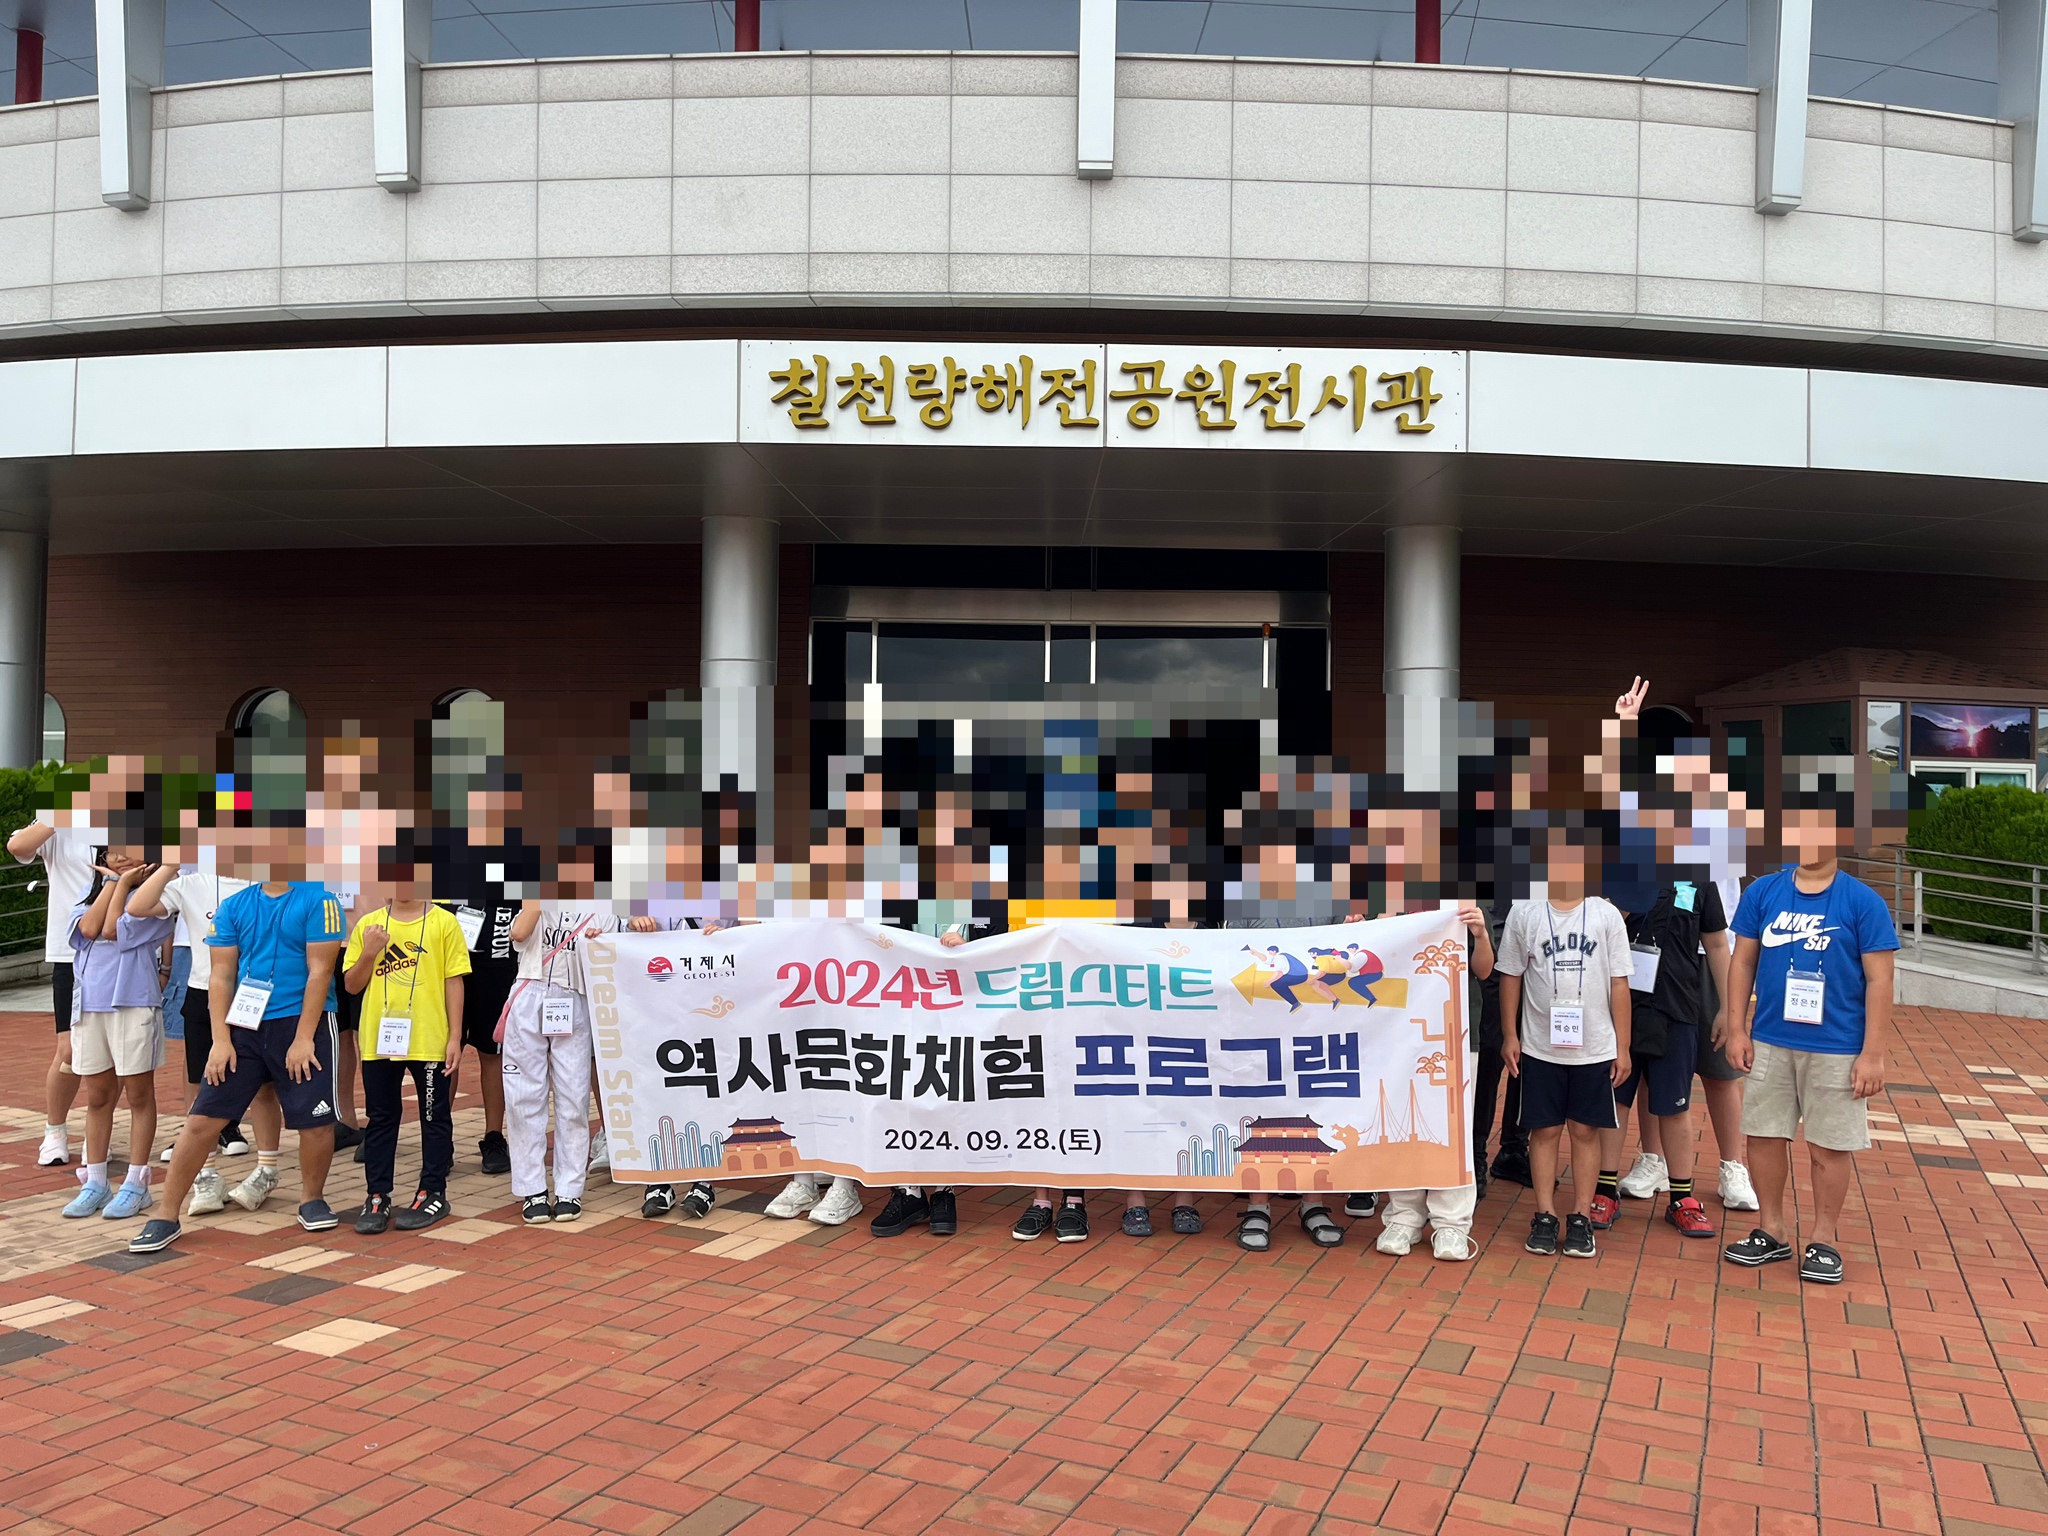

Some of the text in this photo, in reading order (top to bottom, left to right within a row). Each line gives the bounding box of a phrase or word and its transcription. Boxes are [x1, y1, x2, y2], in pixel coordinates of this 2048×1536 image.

[1771, 911, 1826, 932] NIKE
[1542, 932, 1598, 959] GLOW
[1803, 935, 1832, 951] SB
[375, 958, 417, 976] adidas
[680, 954, 736, 970] 거제시
[683, 970, 736, 981] GEOJE-SI
[776, 957, 1219, 1012] 2024년 드림스타트
[586, 942, 642, 1163] Dream Start
[655, 1027, 1361, 1104] 역사문화체험 프로그램
[426, 1070, 435, 1122] new balance
[884, 1127, 1102, 1156] 2024. 09. 28.(토)
